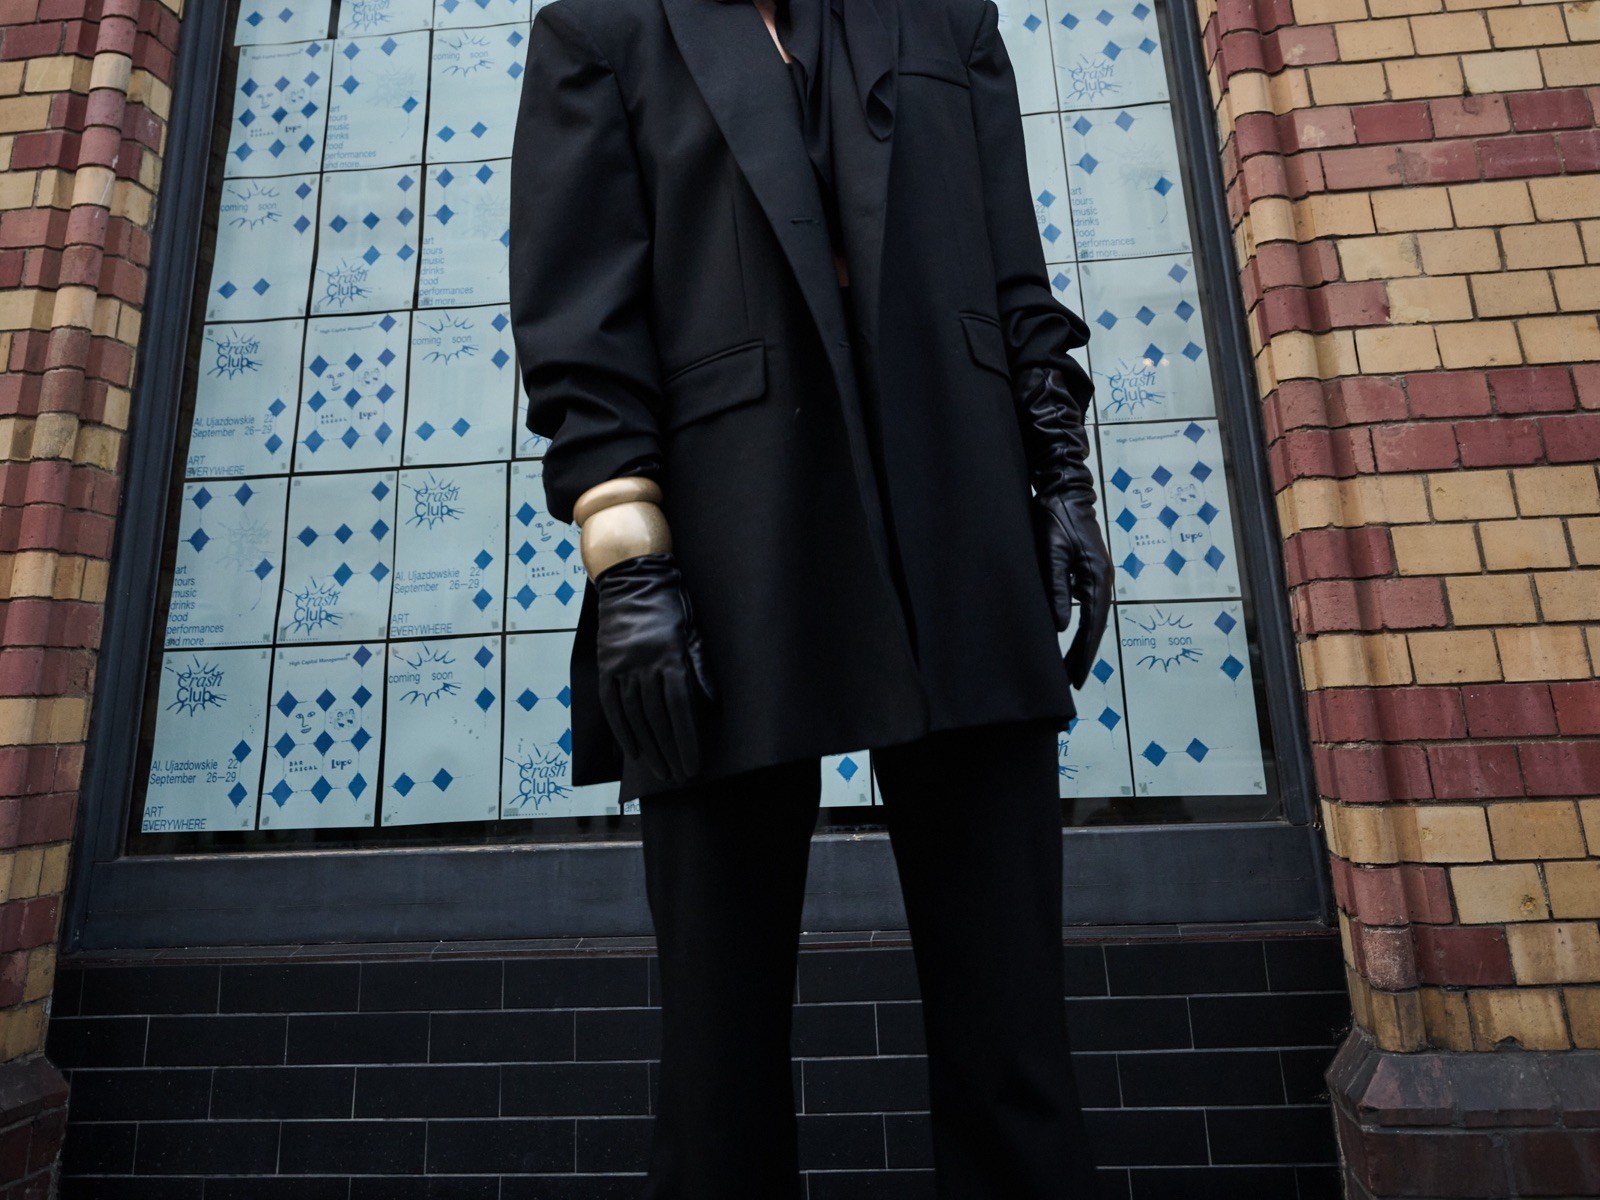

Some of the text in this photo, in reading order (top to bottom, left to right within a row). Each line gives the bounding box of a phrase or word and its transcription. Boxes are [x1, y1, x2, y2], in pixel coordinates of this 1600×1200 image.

[220, 202, 277, 213] coming soon
[1072, 207, 1098, 216] music
[1074, 217, 1100, 226] drinks
[1077, 237, 1136, 248] performances
[420, 267, 445, 275] drinks
[326, 283, 359, 298] Club
[418, 286, 474, 297] performances
[412, 334, 472, 346] coming soon
[216, 354, 249, 368] Club
[1111, 387, 1148, 402] Club
[206, 415, 255, 428] Ujazdowskie
[192, 427, 235, 439] September
[188, 456, 206, 465] ART
[415, 488, 459, 504] Crash
[415, 502, 451, 517] Club
[1180, 532, 1203, 543] Lupo
[175, 565, 187, 575] art
[408, 567, 460, 581] Ujazdowskie
[470, 566, 480, 577] 22
[174, 577, 196, 587] tours
[394, 581, 439, 594] September
[172, 588, 197, 598] music
[295, 591, 340, 608] Crash
[170, 600, 196, 610] drinks
[168, 612, 188, 622] food
[294, 606, 328, 622] Club
[391, 612, 410, 624] ART
[166, 623, 224, 636] performances
[390, 623, 452, 637] EVERYWHERE
[1121, 635, 1192, 649] coming soon
[301, 658, 317, 666] Capital
[319, 656, 349, 664] Management
[177, 671, 224, 688] Crash
[388, 671, 453, 684] coming soon
[176, 687, 211, 703] Club
[151, 758, 238, 773] Al. Ujazdowskie 22
[331, 759, 352, 770] Lupo
[518, 760, 567, 779] Crash
[150, 773, 196, 788] September
[519, 778, 557, 795] Club
[144, 806, 164, 818] ART
